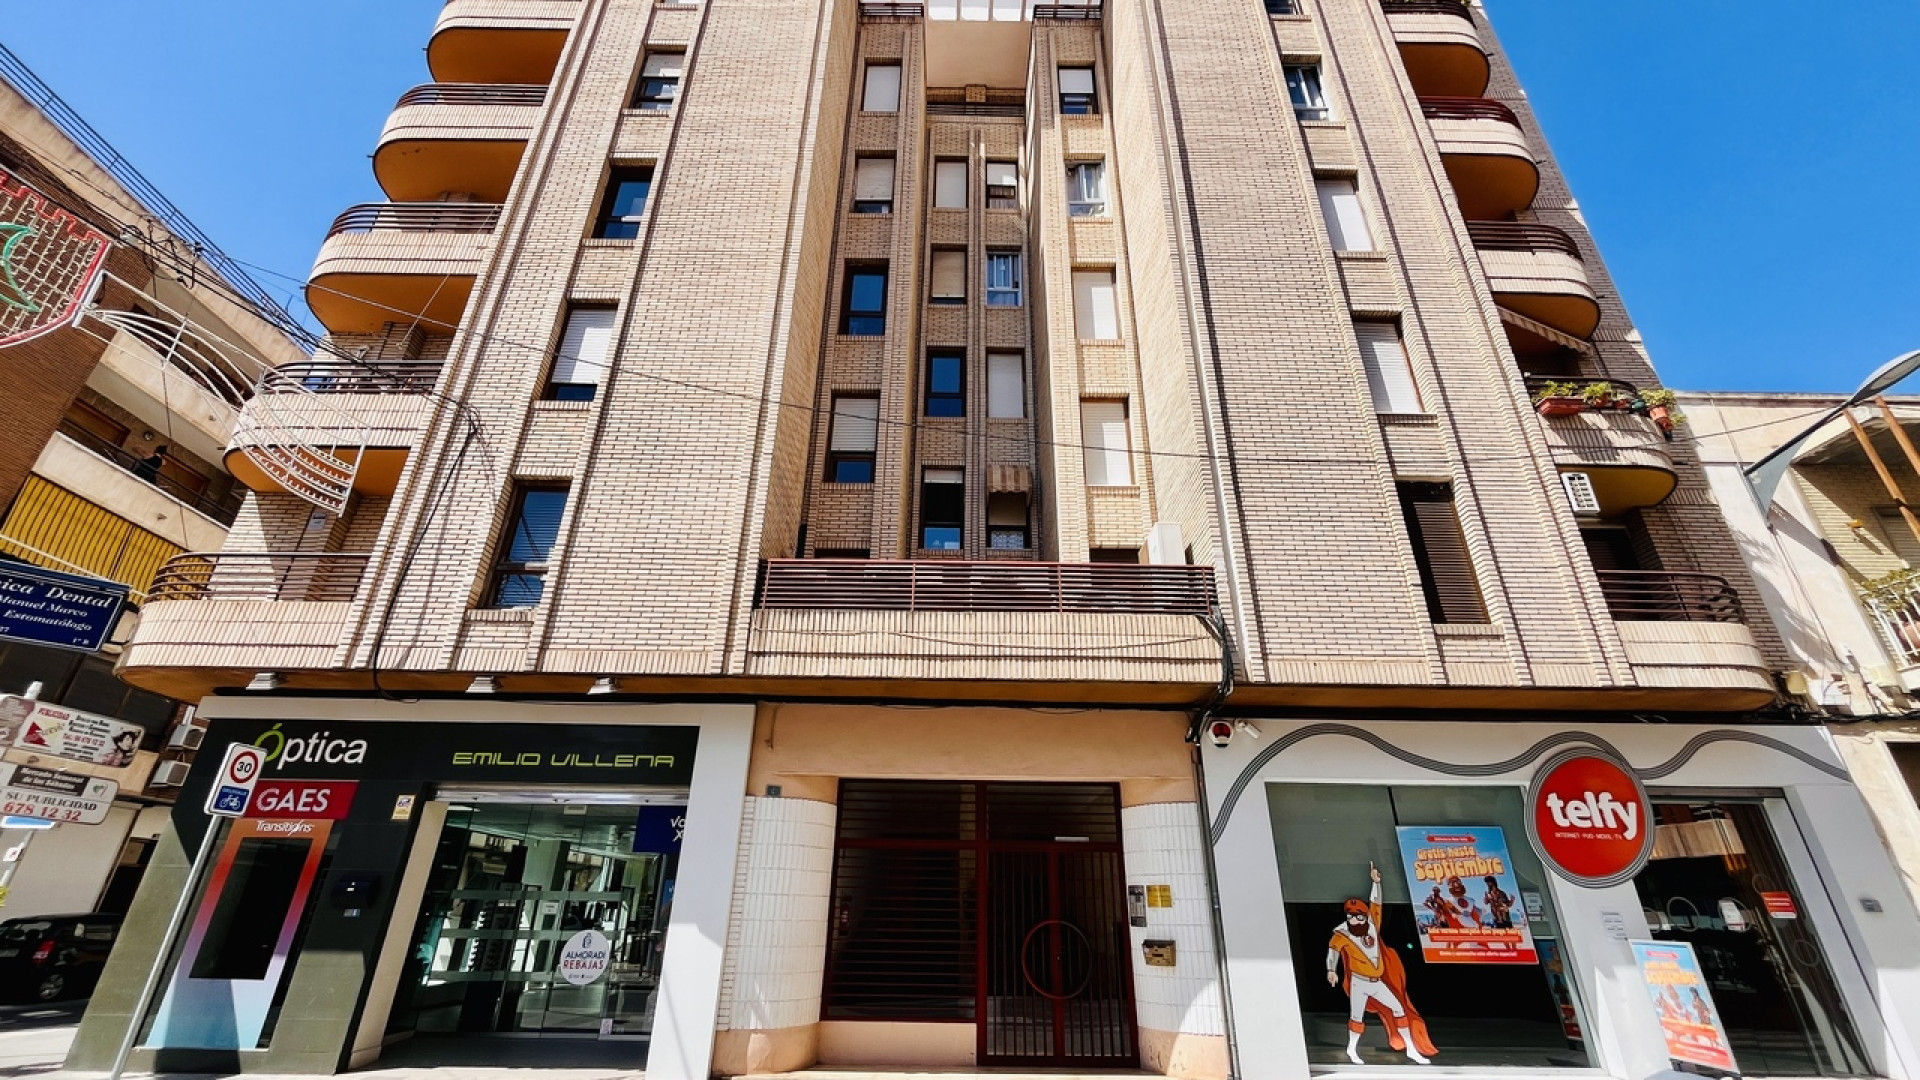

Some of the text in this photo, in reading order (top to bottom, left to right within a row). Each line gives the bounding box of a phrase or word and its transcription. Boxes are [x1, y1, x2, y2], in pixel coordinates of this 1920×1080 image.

[45, 587, 113, 608] Dental
[46, 603, 88, 617] Marco
[254, 722, 368, 770] Óptica
[236, 761, 252, 773] 30
[453, 752, 675, 768] EMILIO VILLENA
[6, 792, 97, 811] SU PUBLICIDAD
[256, 787, 331, 813] GAES
[4, 802, 82, 821] 678 12 32
[1546, 791, 1638, 840] telfy
[1414, 857, 1505, 884] Septiembre
[563, 959, 604, 970] REBAJAS
